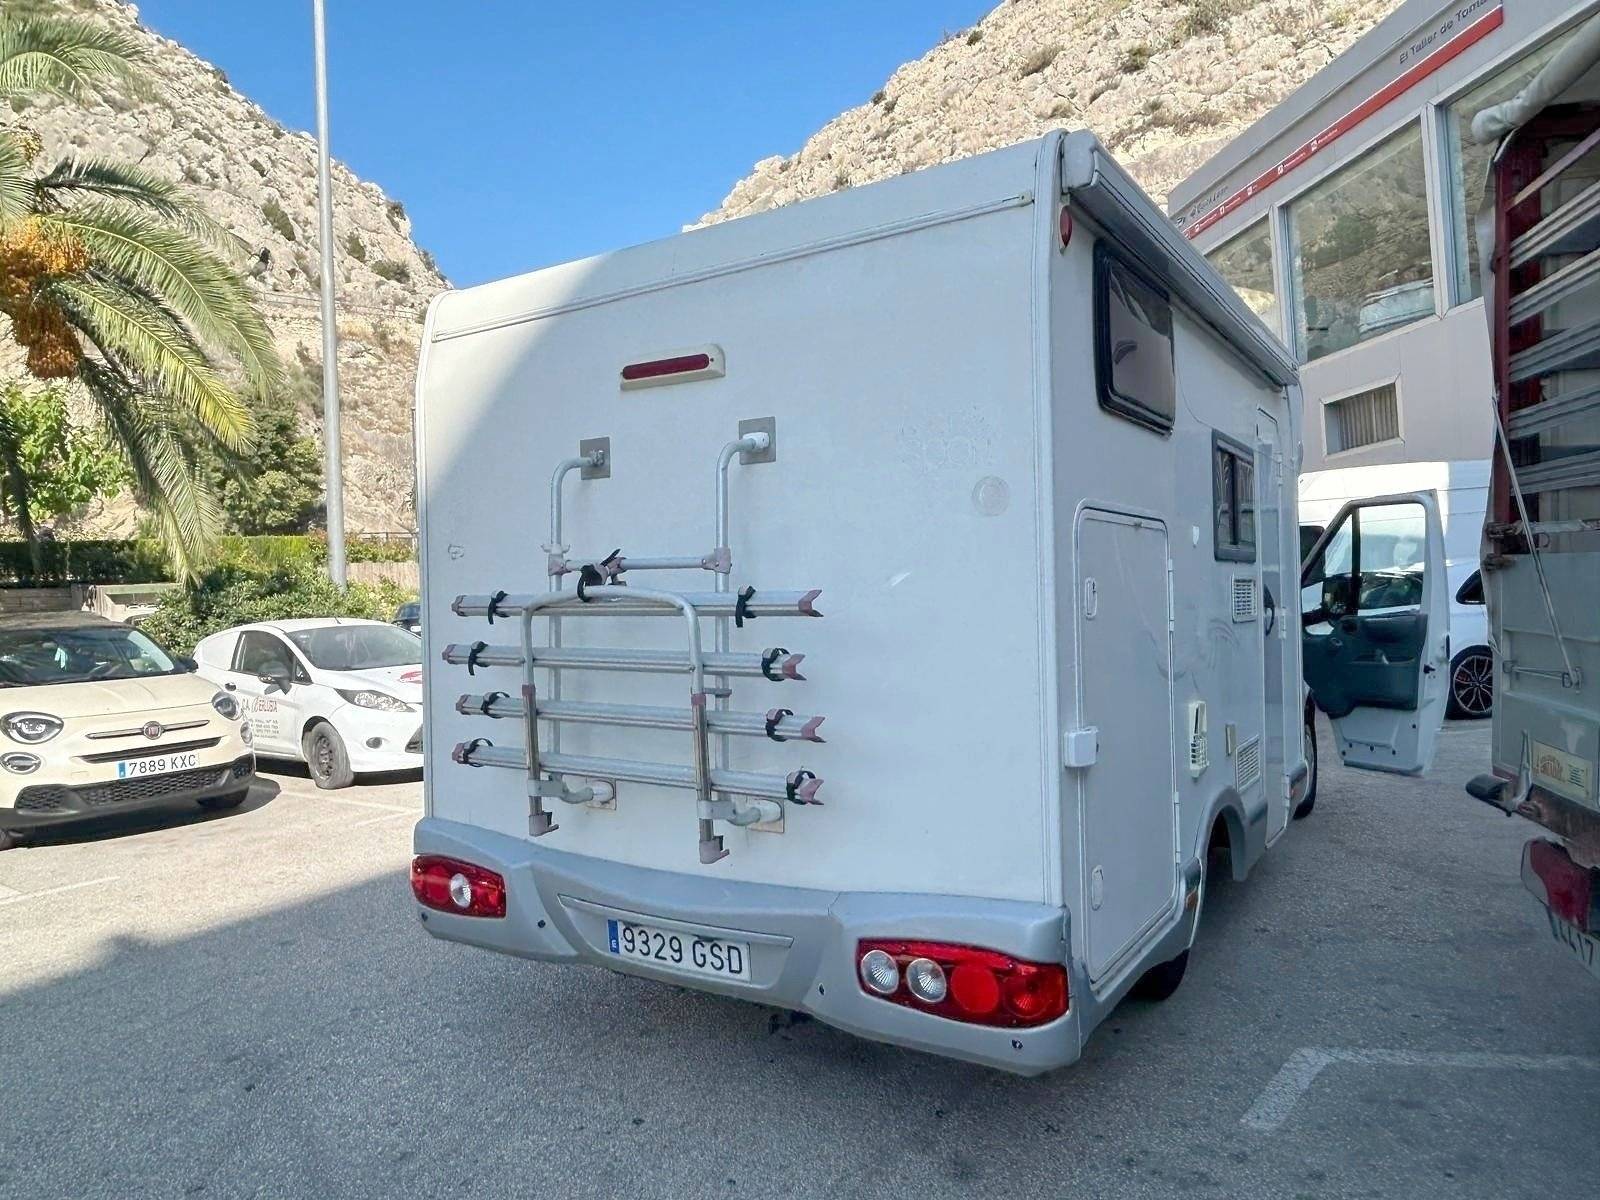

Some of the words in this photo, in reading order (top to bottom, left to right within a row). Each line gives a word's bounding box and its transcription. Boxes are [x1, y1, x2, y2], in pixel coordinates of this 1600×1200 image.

[129, 759, 166, 776] 7889
[170, 754, 196, 770] KXC
[622, 926, 683, 964] 9329
[691, 939, 743, 974] GSD
